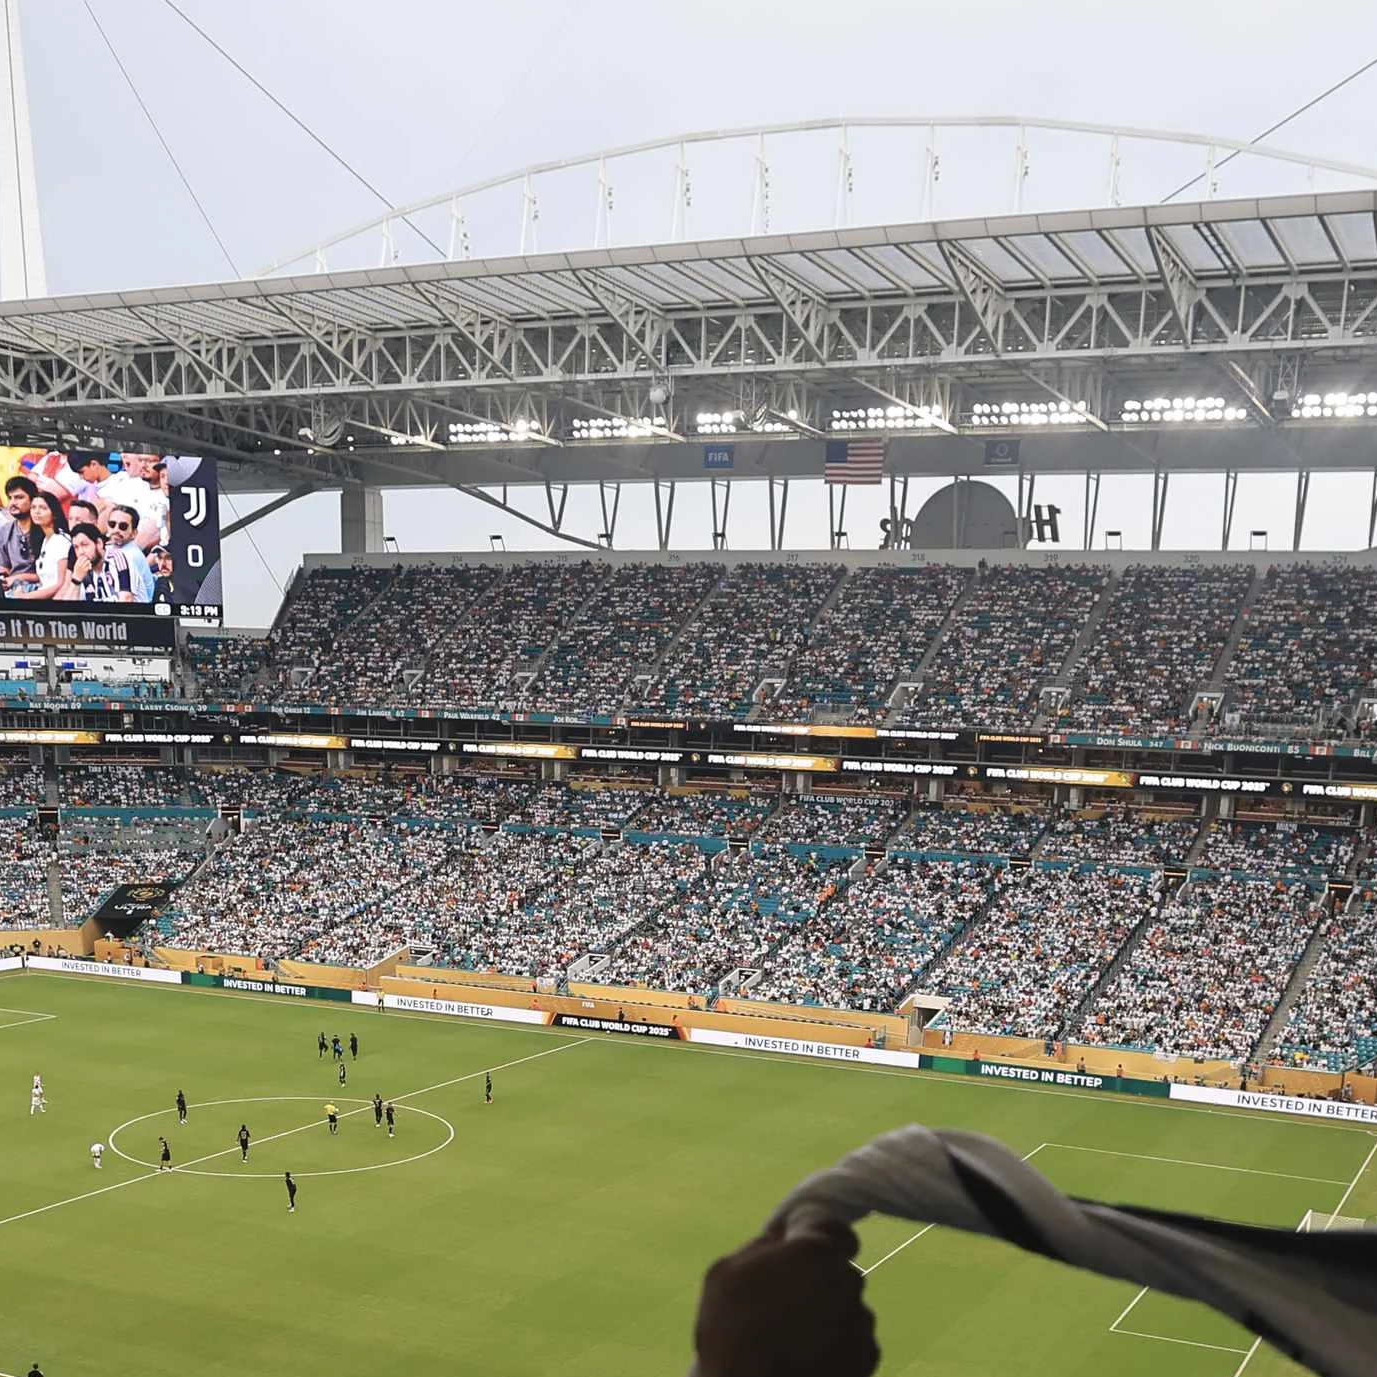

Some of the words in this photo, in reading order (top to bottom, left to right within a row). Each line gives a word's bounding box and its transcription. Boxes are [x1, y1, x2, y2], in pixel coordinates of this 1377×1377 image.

[708, 453, 729, 462] FIFA
[187, 544, 203, 567] 0
[204, 606, 218, 616] PM
[10, 619, 23, 637] It
[26, 620, 44, 637] To
[48, 621, 78, 639] The
[82, 621, 127, 640] World
[1097, 738, 1115, 746] DON
[1117, 738, 1143, 748] SHULA
[1204, 742, 1225, 751] NICK
[1227, 744, 1280, 754] BUONICONTI
[1354, 749, 1370, 758] BILL
[62, 962, 100, 972] INVESTED
[102, 965, 110, 973] IN
[112, 966, 141, 976] BETTER
[224, 979, 263, 991] INVESTED
[264, 983, 273, 992] IN
[275, 984, 306, 996] BETTER
[397, 998, 442, 1010] INVESTED
[445, 1002, 454, 1012] IN
[457, 1003, 493, 1016] BETTER
[562, 1017, 579, 1026] FIFA
[580, 1019, 600, 1028] CLUB
[601, 1021, 630, 1031] WORLD
[632, 1024, 648, 1033] CUP
[745, 1037, 798, 1051] INVESTED
[803, 1043, 813, 1053] IN
[817, 1045, 860, 1058] BETTER
[981, 1064, 1038, 1080] INVESTED
[1042, 1071, 1053, 1081] IN
[1237, 1095, 1304, 1111] INVESTED
[1308, 1102, 1322, 1113] IN
